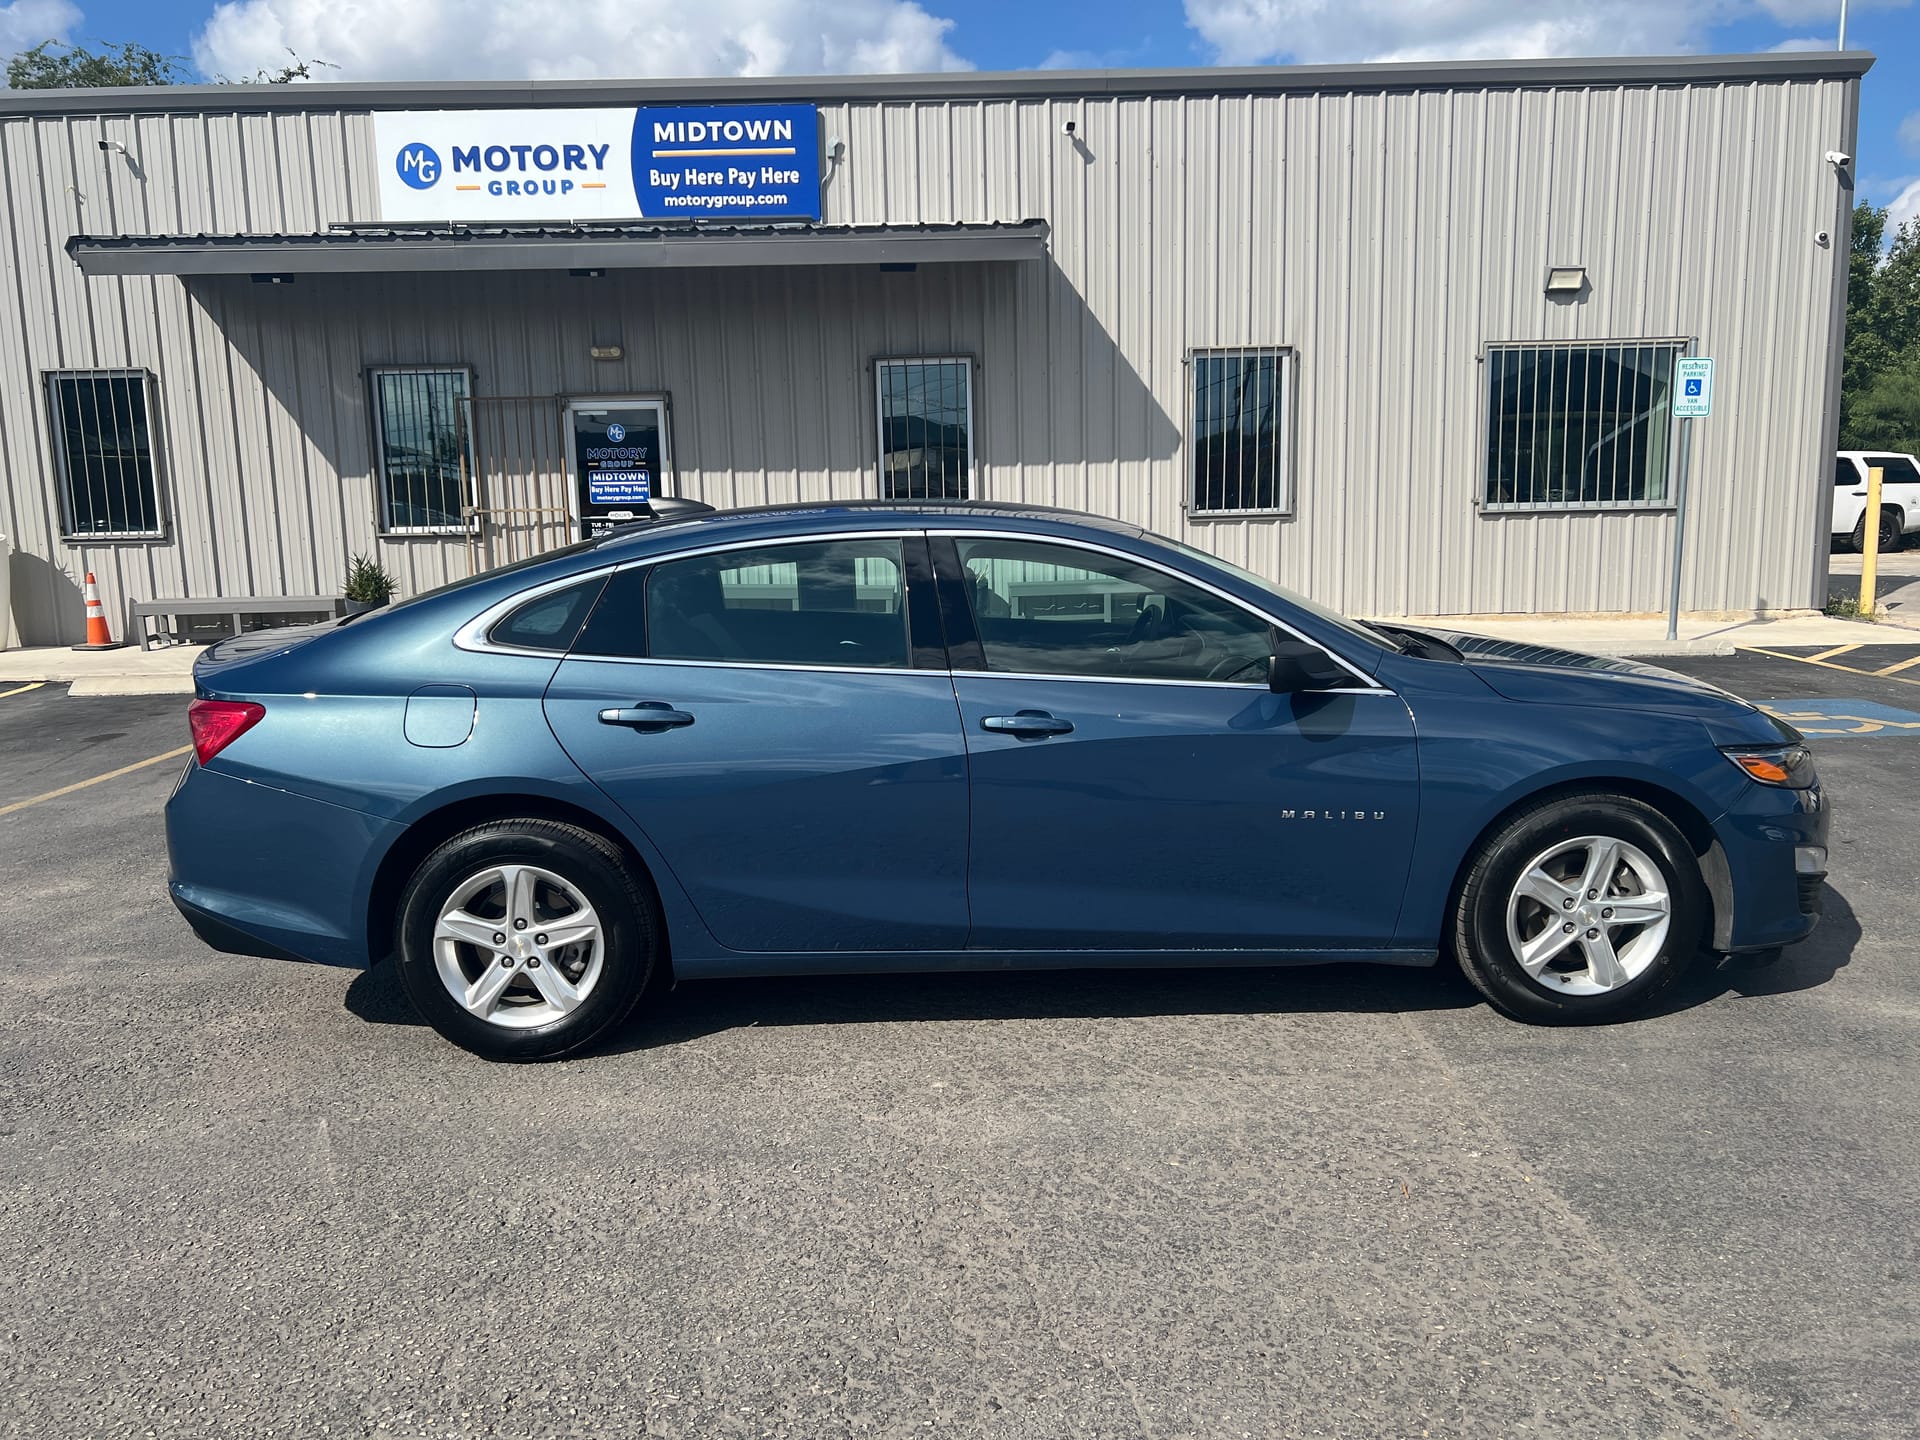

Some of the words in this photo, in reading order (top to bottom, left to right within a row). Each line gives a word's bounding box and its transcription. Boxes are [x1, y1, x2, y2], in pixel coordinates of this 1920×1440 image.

[653, 120, 793, 144] MIDTOWN
[453, 144, 610, 172] MOTORY
[650, 169, 680, 190] Buy
[685, 168, 724, 186] Here
[728, 168, 756, 188] Pay
[760, 167, 800, 184] Here
[488, 179, 574, 196] GROUP
[664, 193, 788, 209] motorygroup.com
[587, 448, 647, 459] MOTORY
[593, 473, 645, 481] MIDTOWN
[592, 486, 603, 494] Buy
[1281, 810, 1385, 820] MALIBU
